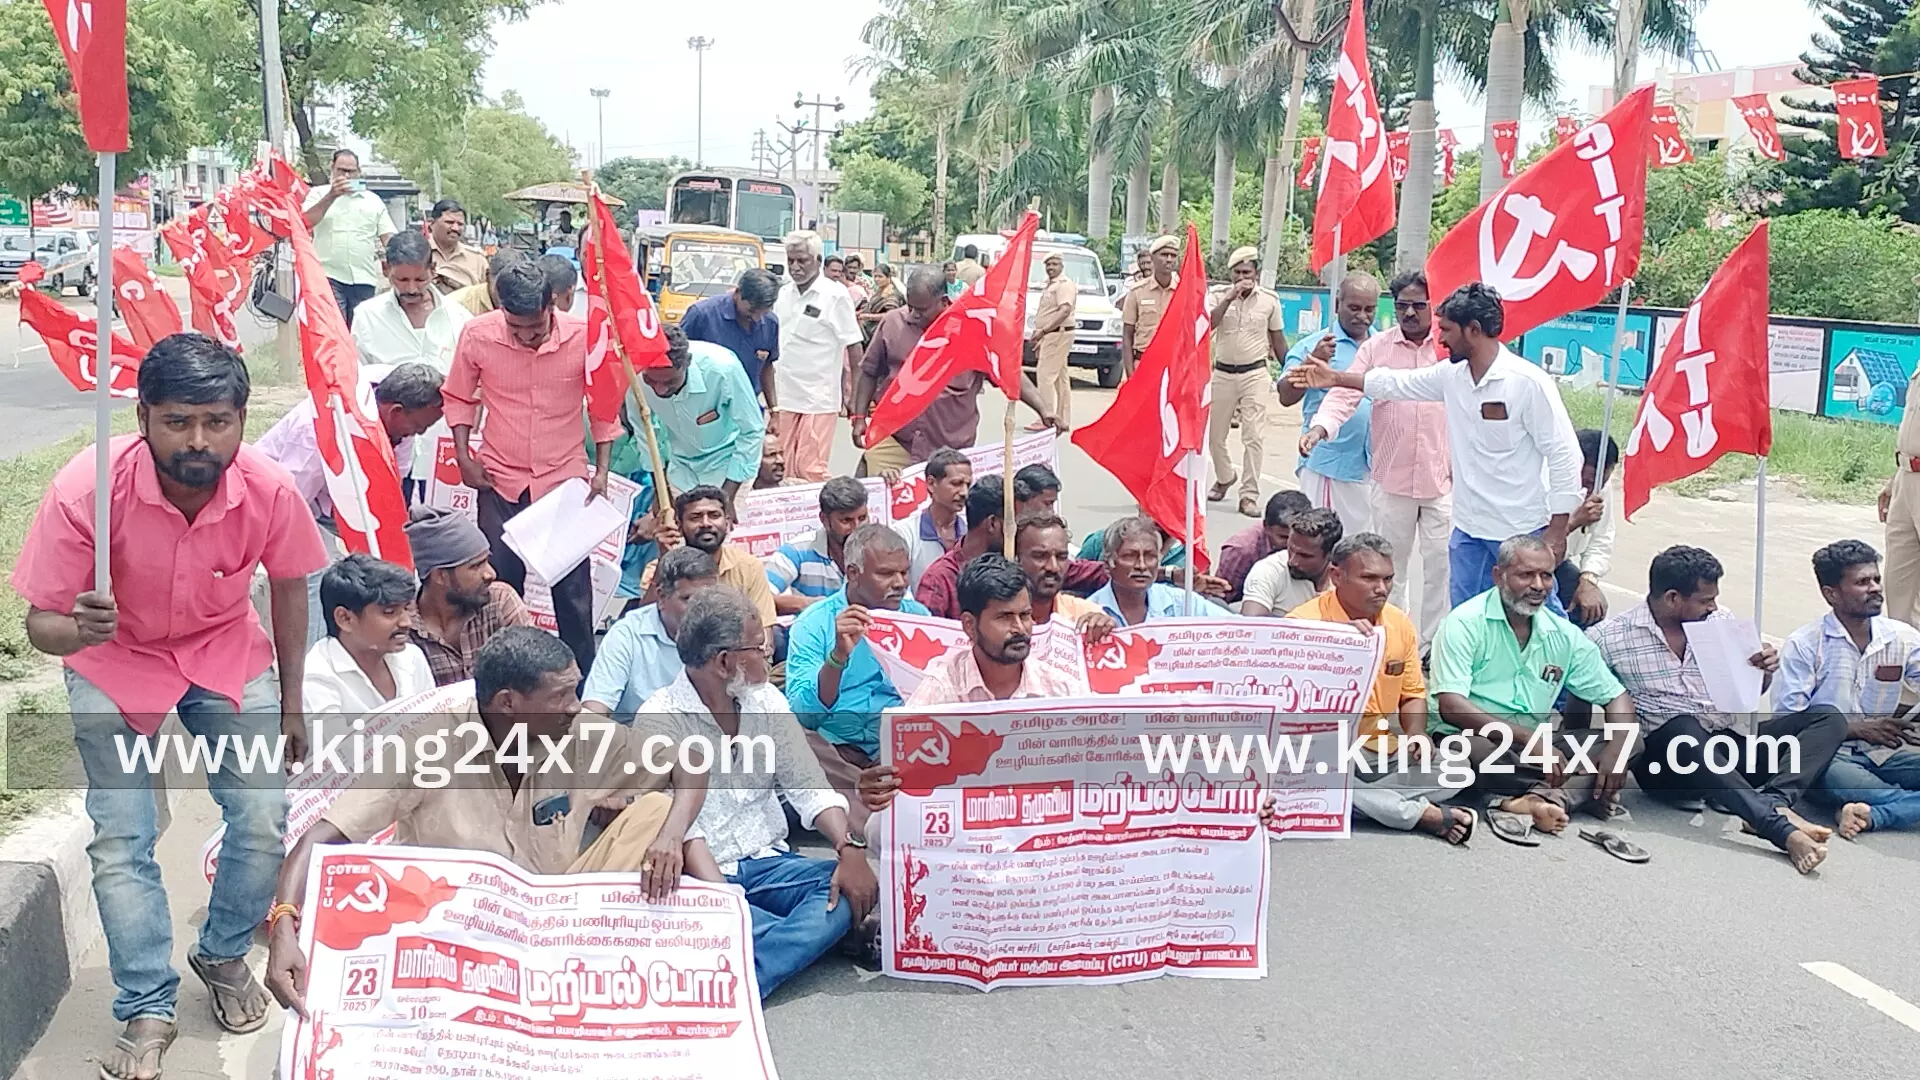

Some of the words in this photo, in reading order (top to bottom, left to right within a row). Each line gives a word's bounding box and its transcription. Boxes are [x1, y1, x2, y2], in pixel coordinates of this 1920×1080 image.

[453, 494, 469, 509] 23
[1010, 715, 1067, 732] தமிழக
[1145, 712, 1179, 724] மின்
[1018, 736, 1045, 750] மின்
[1049, 734, 1119, 750] வாரியத்தில்
[966, 786, 1017, 823] மாநிலம்
[1021, 785, 1072, 824] தழுவிய
[1079, 768, 1180, 830] மறியல்
[1182, 766, 1261, 814] போர்
[925, 811, 950, 834] 23
[979, 843, 993, 855] 10
[467, 871, 519, 898] தமிழக
[601, 890, 643, 904] மின்
[472, 898, 502, 915] மின்
[572, 915, 649, 932] பணிபுரியும்
[651, 917, 703, 934] ஒப்பந்த
[1108, 951, 1148, 972] (CITU)
[346, 967, 378, 996] 23
[524, 955, 648, 1018] மறியல்
[649, 954, 739, 1009] போர்
[342, 1000, 367, 1012] 2025
[410, 1005, 427, 1020] 10
